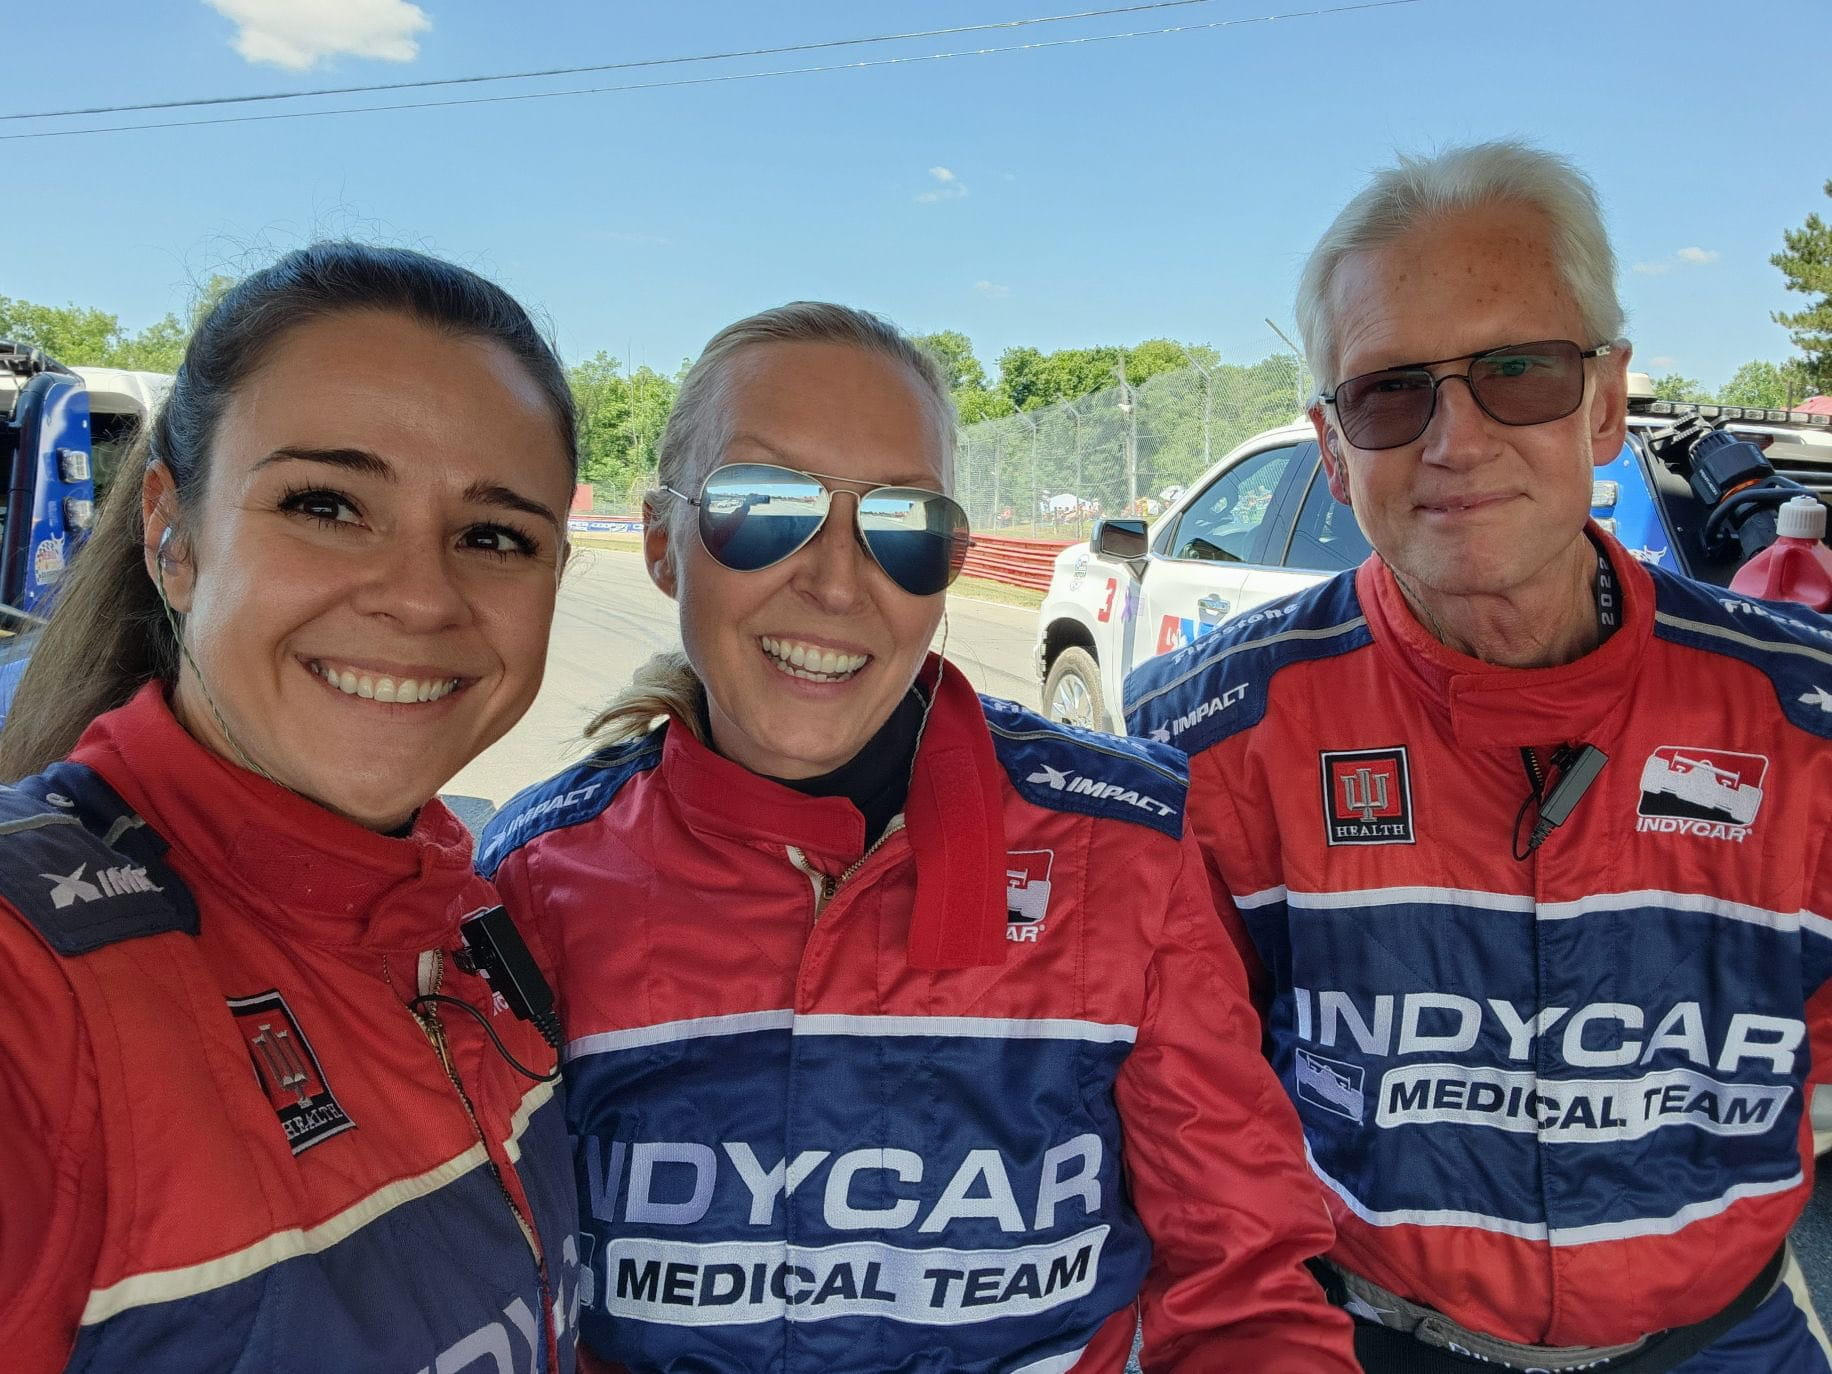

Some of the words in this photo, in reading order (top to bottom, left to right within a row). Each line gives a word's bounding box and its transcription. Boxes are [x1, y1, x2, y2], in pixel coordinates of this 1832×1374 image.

[1098, 577, 1117, 623] 3
[1599, 557, 1615, 625] 2022
[1173, 682, 1249, 736] IMPACT
[506, 783, 602, 837] IMPACT
[1066, 777, 1177, 817] IMPACT
[1336, 824, 1405, 837] HEALTH
[1636, 817, 1748, 843] INDYCAR
[1294, 987, 1806, 1075] INDYCAR
[282, 1104, 343, 1141] HEALTH
[1389, 1079, 1627, 1129] MEDICAL
[1644, 1084, 1776, 1125] TEAM
[569, 1133, 1102, 1233] NDYCAR
[615, 1258, 898, 1306] MEDICAL
[924, 1244, 1092, 1309] TEAM
